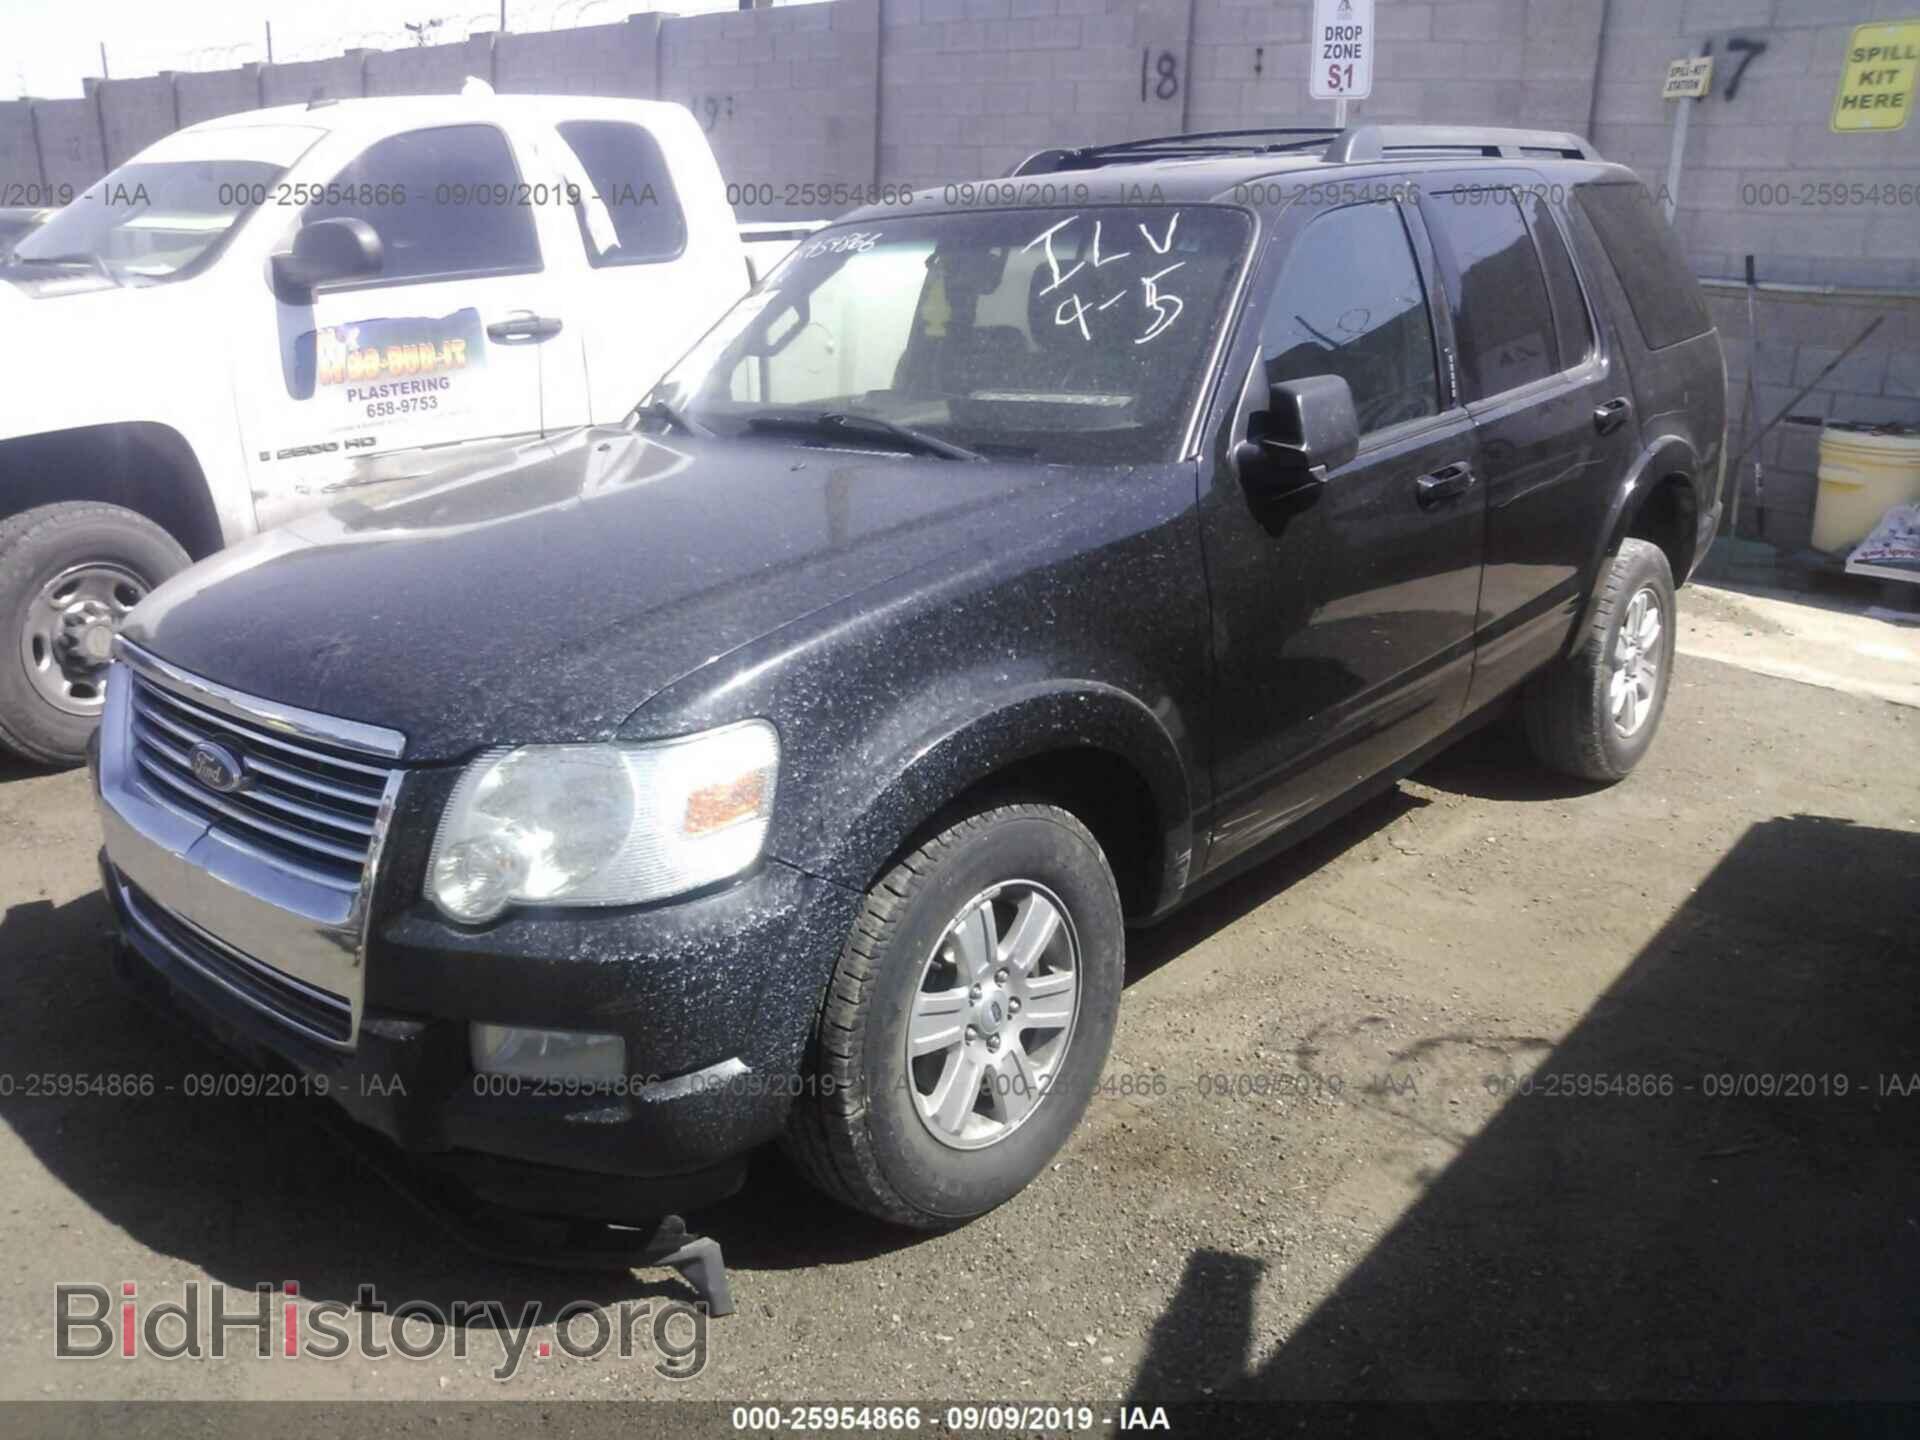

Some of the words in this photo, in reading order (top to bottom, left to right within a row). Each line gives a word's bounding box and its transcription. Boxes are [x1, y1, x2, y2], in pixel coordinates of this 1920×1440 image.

[1325, 26, 1362, 41] DROP
[1323, 44, 1362, 59] ZONE
[1850, 46, 1918, 62] SPILL
[1141, 47, 1178, 102] 18
[1859, 70, 1899, 86] KIT
[1842, 93, 1905, 110] HERE
[347, 376, 450, 402] PLASTERING
[366, 395, 438, 418] 658-9753
[344, 436, 376, 449] HD
